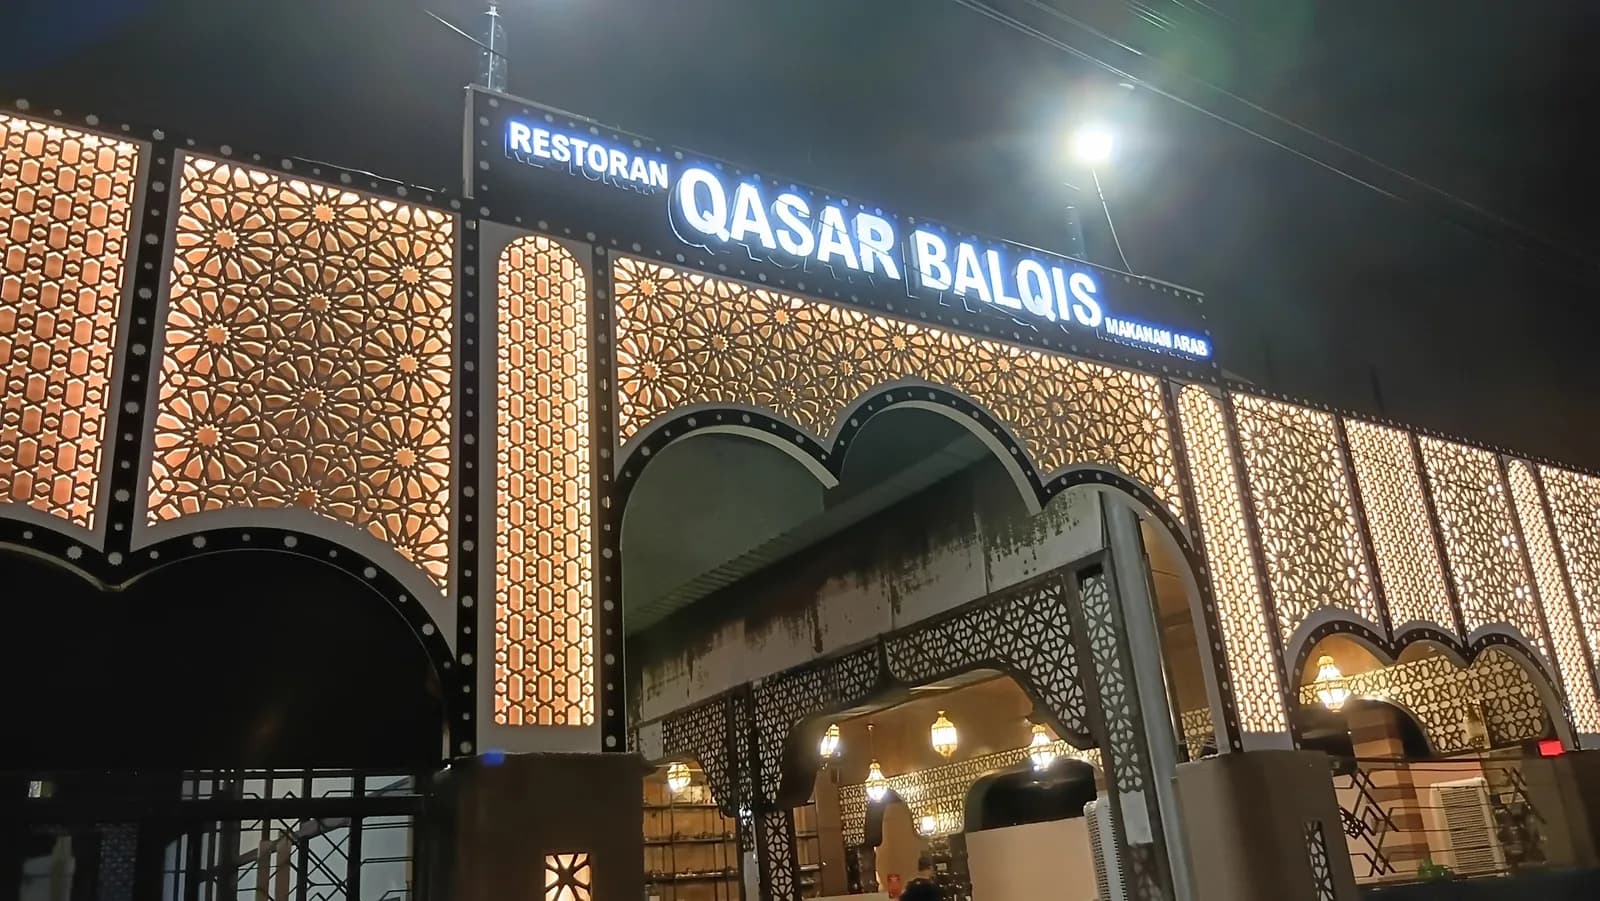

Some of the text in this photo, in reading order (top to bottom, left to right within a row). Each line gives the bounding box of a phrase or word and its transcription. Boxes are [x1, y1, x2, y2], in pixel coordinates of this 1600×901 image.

[508, 120, 669, 189] RESTORAN
[675, 167, 1103, 328] QASAR BALQIS
[1173, 332, 1208, 357] ARAB
